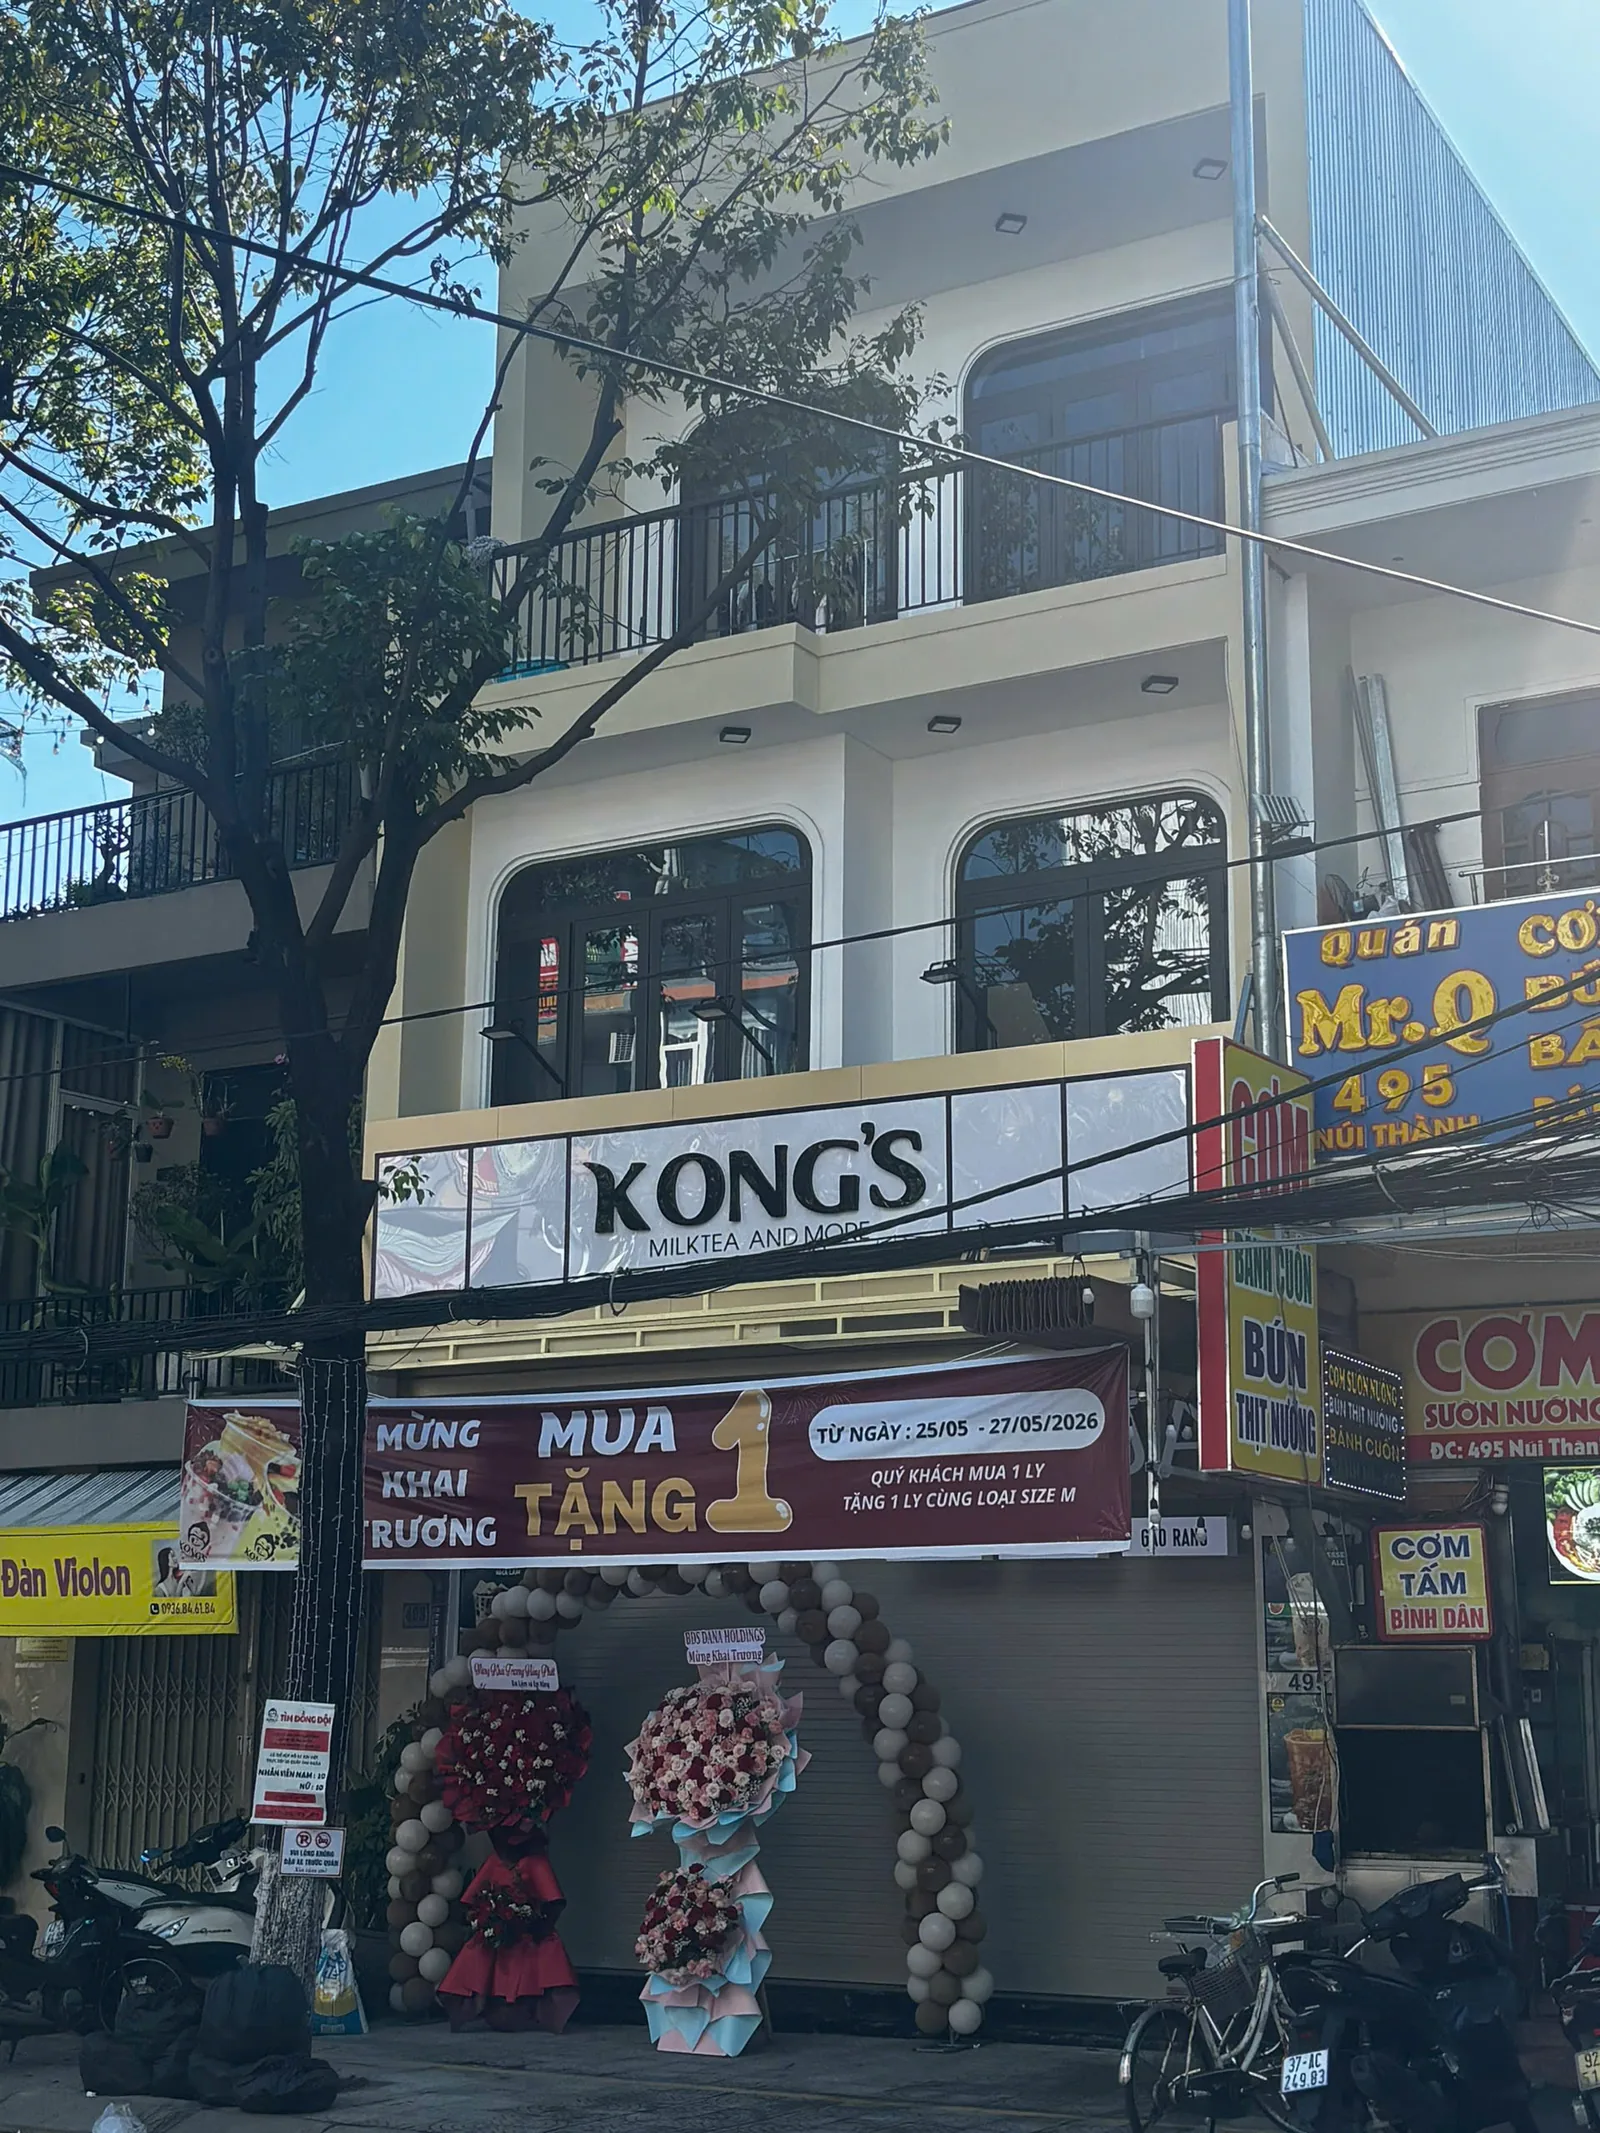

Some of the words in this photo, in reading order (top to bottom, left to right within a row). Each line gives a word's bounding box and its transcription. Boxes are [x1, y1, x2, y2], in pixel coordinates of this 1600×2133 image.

[1321, 919, 1458, 966] Quán
[1518, 901, 1600, 957] CƠ
[1296, 968, 1497, 1055] Mr.Q
[1333, 1064, 1455, 1114] 495
[1314, 1120, 1365, 1150] NÚI
[1372, 1113, 1480, 1147] THÀNH
[649, 1233, 739, 1258] MILKTEA
[749, 1226, 799, 1250] AND
[1243, 1318, 1307, 1390] BÚN
[1416, 1314, 1600, 1393] CƠM
[376, 1410, 482, 1452] MỪNG
[537, 1406, 678, 1459] MUA
[816, 1423, 845, 1444] TỪ
[849, 1420, 902, 1443] NGÀY
[915, 1420, 969, 1440] 25/05
[988, 1412, 1099, 1435] 27/05/2026
[1236, 1391, 1268, 1453] THỊT
[1270, 1396, 1317, 1455] NƯỚNG
[1430, 1441, 1463, 1460] ĐC:
[1468, 1439, 1504, 1459] 495
[1510, 1438, 1544, 1457] Núi
[1549, 1436, 1600, 1456] Thàn
[381, 1469, 469, 1498] KHAI
[870, 1465, 905, 1488] QUÝ
[908, 1464, 964, 1485] KHÁCH
[968, 1465, 1007, 1482] MUA
[1012, 1463, 1020, 1480] 1
[1025, 1462, 1046, 1479] LY
[513, 1467, 698, 1551] TẶNG
[843, 1491, 886, 1514] TẶNG
[890, 1494, 899, 1509] 1
[903, 1492, 923, 1509] LY
[926, 1488, 974, 1508] CÙNG
[977, 1488, 1016, 1509] LOẠI
[1020, 1487, 1056, 1505] SIZE
[1060, 1486, 1077, 1503] M
[1390, 1532, 1471, 1561] CƠM
[1, 1558, 48, 1598] Đàn
[54, 1556, 131, 1597] Violon
[1399, 1562, 1467, 1597] TẤM
[1390, 1605, 1438, 1630] BÌNH
[1443, 1603, 1484, 1629] DÂN
[724, 1627, 765, 1644] HOLDINGS
[1284, 2068, 1326, 2091] 249.83
[1288, 2052, 1322, 2073] 37-AC
